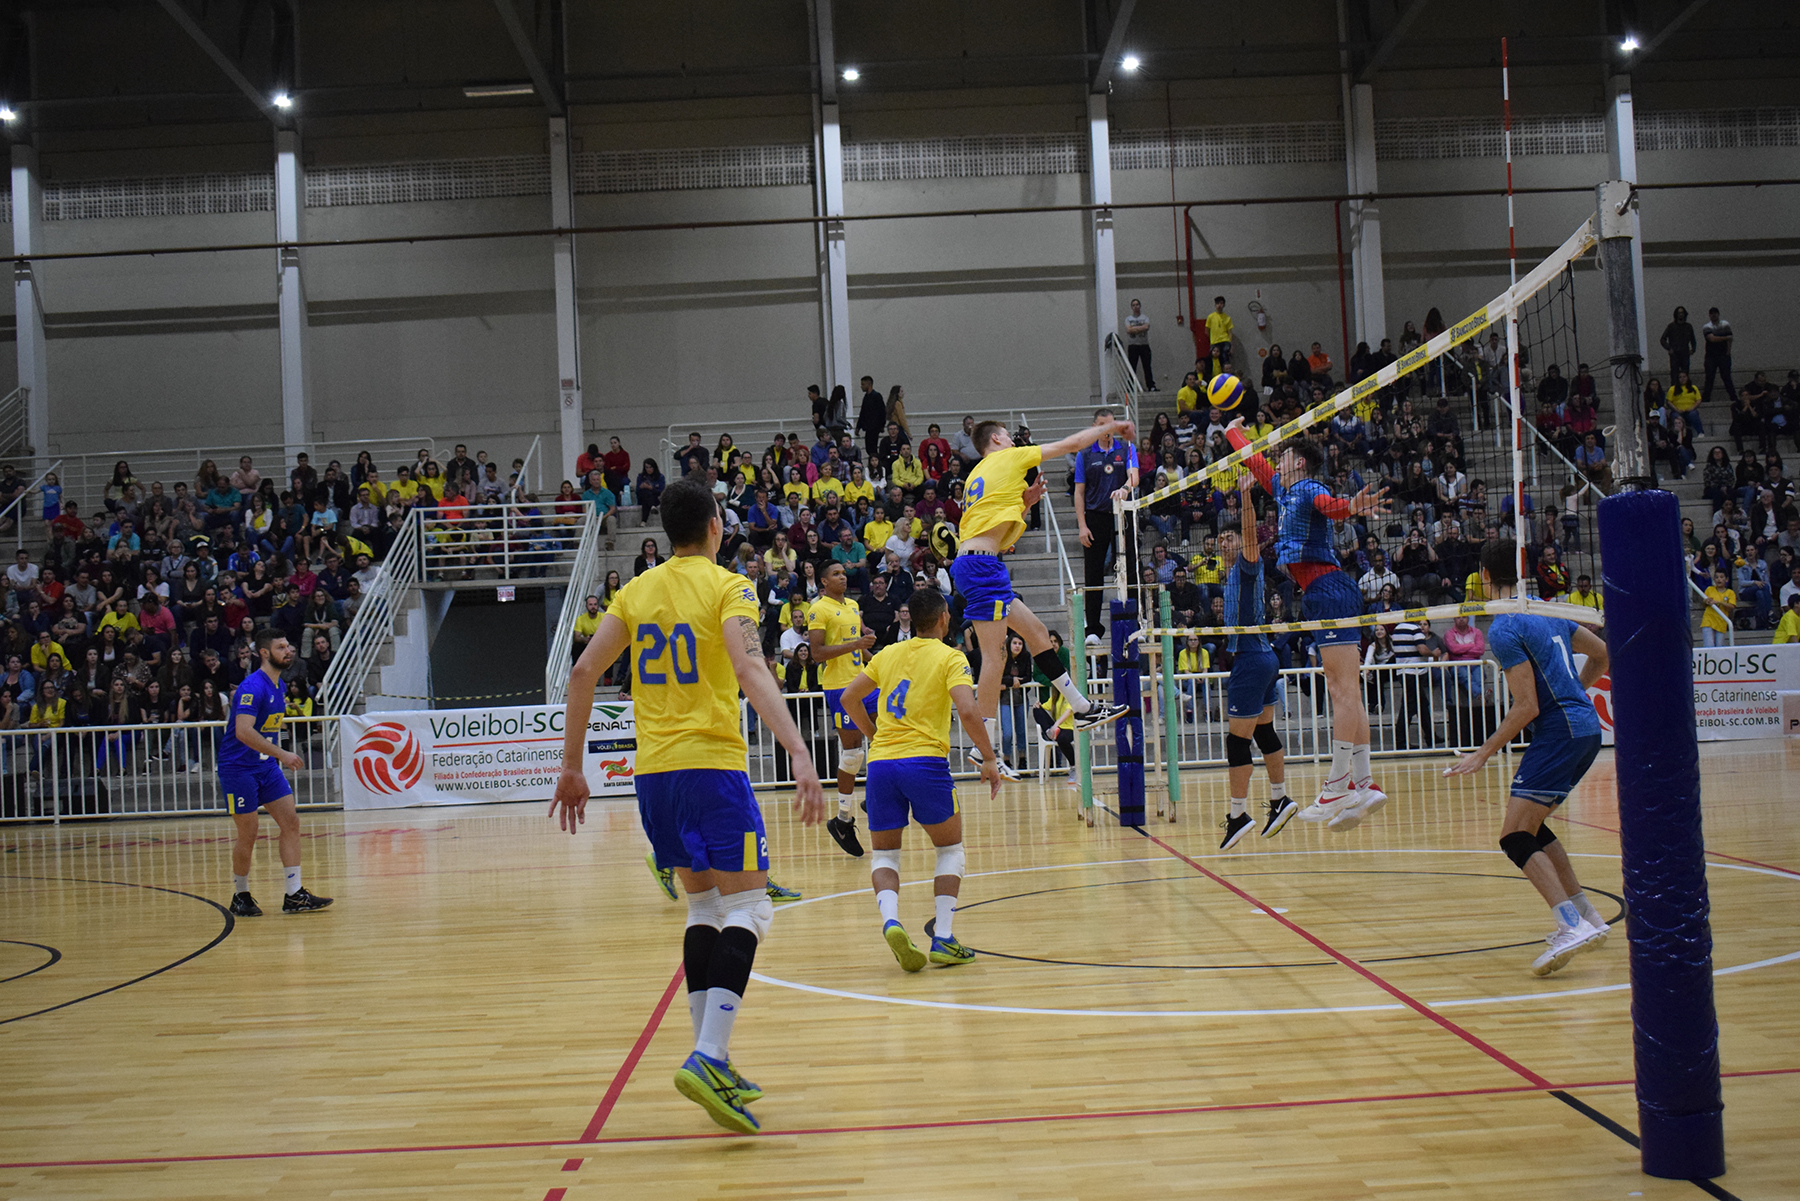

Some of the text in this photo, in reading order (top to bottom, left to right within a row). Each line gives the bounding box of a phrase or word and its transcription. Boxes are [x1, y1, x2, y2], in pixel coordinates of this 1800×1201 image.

[636, 622, 699, 685] 20
[1552, 635, 1574, 679] 1
[886, 678, 912, 720] 4
[1711, 688, 1777, 703] Catarinense
[843, 714, 851, 725] 9
[1717, 706, 1744, 716] Brasileira
[1746, 706, 1753, 714] de
[1754, 706, 1779, 714] Voleibol
[429, 711, 565, 739] Voleibol-SC
[433, 747, 564, 768] Federação Catarinense
[434, 772, 454, 780] Filiada
[455, 770, 460, 779] à
[460, 769, 502, 779] Confederação
[503, 767, 533, 776] Brasileira
[533, 766, 541, 774] de
[237, 796, 246, 808] 2
